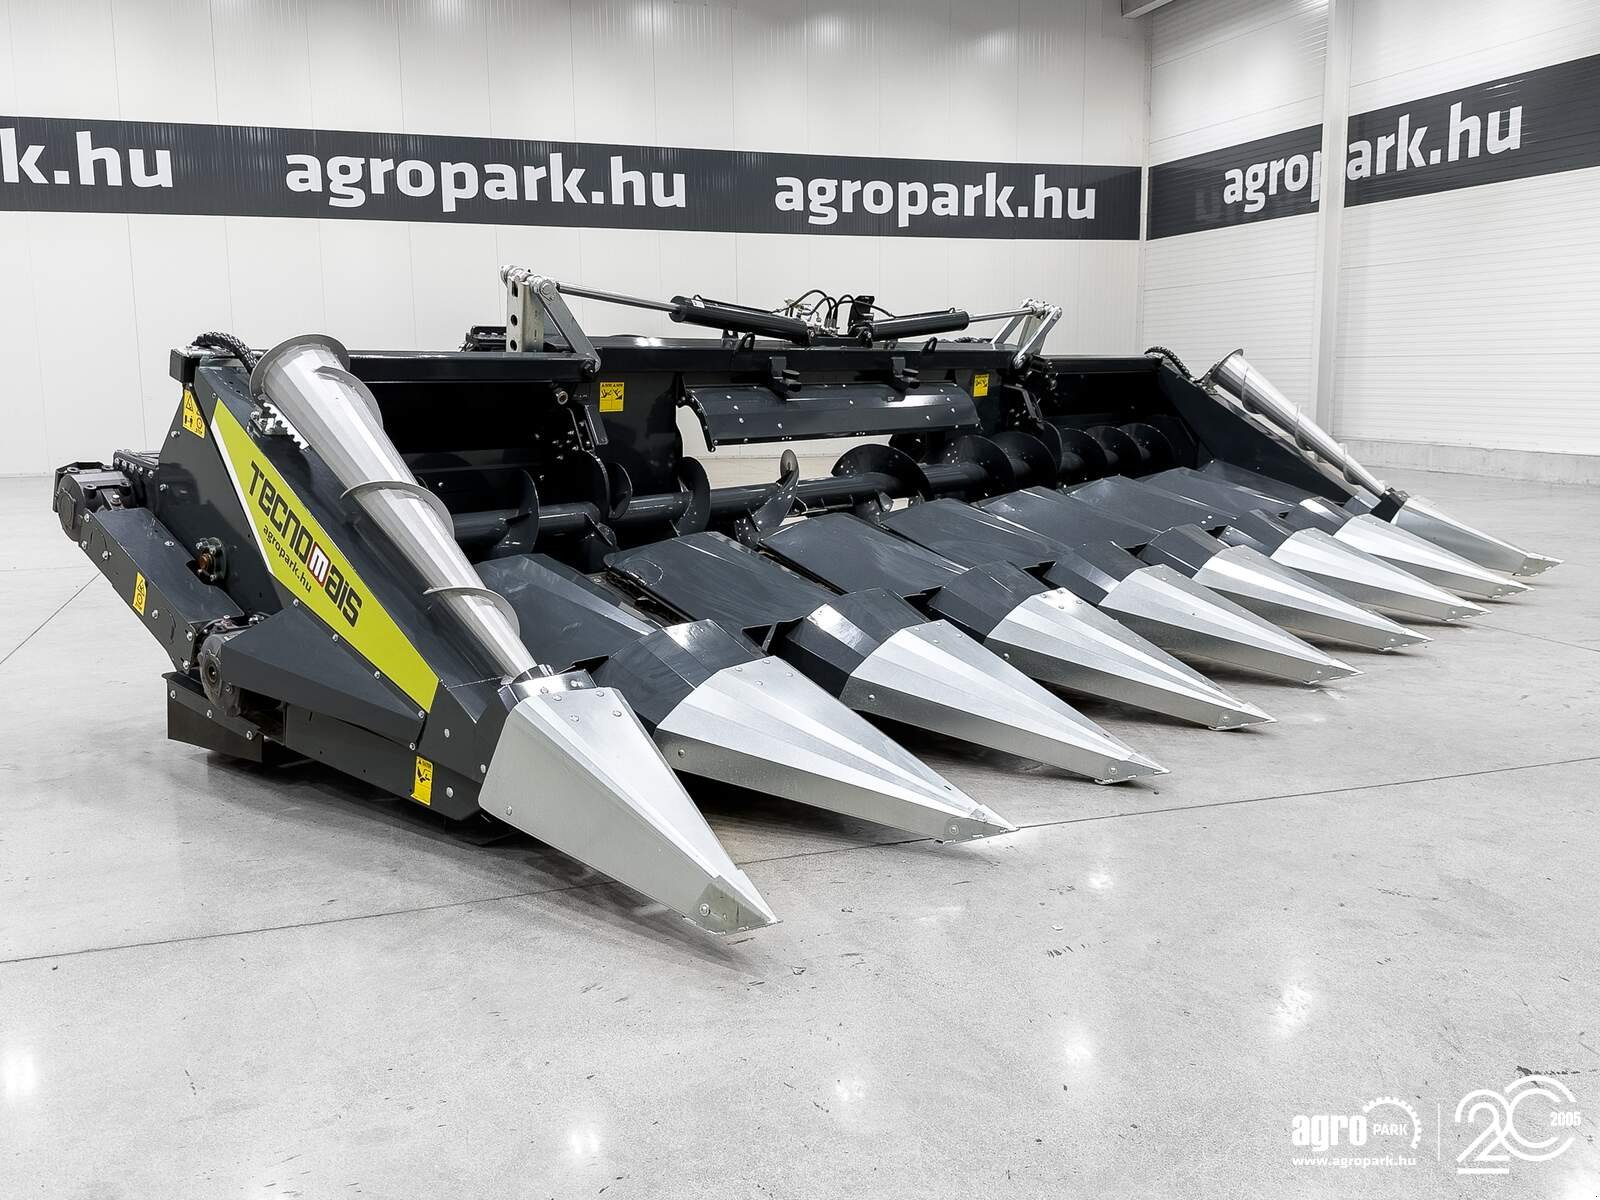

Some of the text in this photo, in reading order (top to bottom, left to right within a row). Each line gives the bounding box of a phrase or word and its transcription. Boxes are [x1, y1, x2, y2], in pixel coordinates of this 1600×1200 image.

[286, 152, 686, 213] agropark.hu
[775, 172, 1096, 228] agropark.hu
[263, 524, 312, 593] agropark.hu
